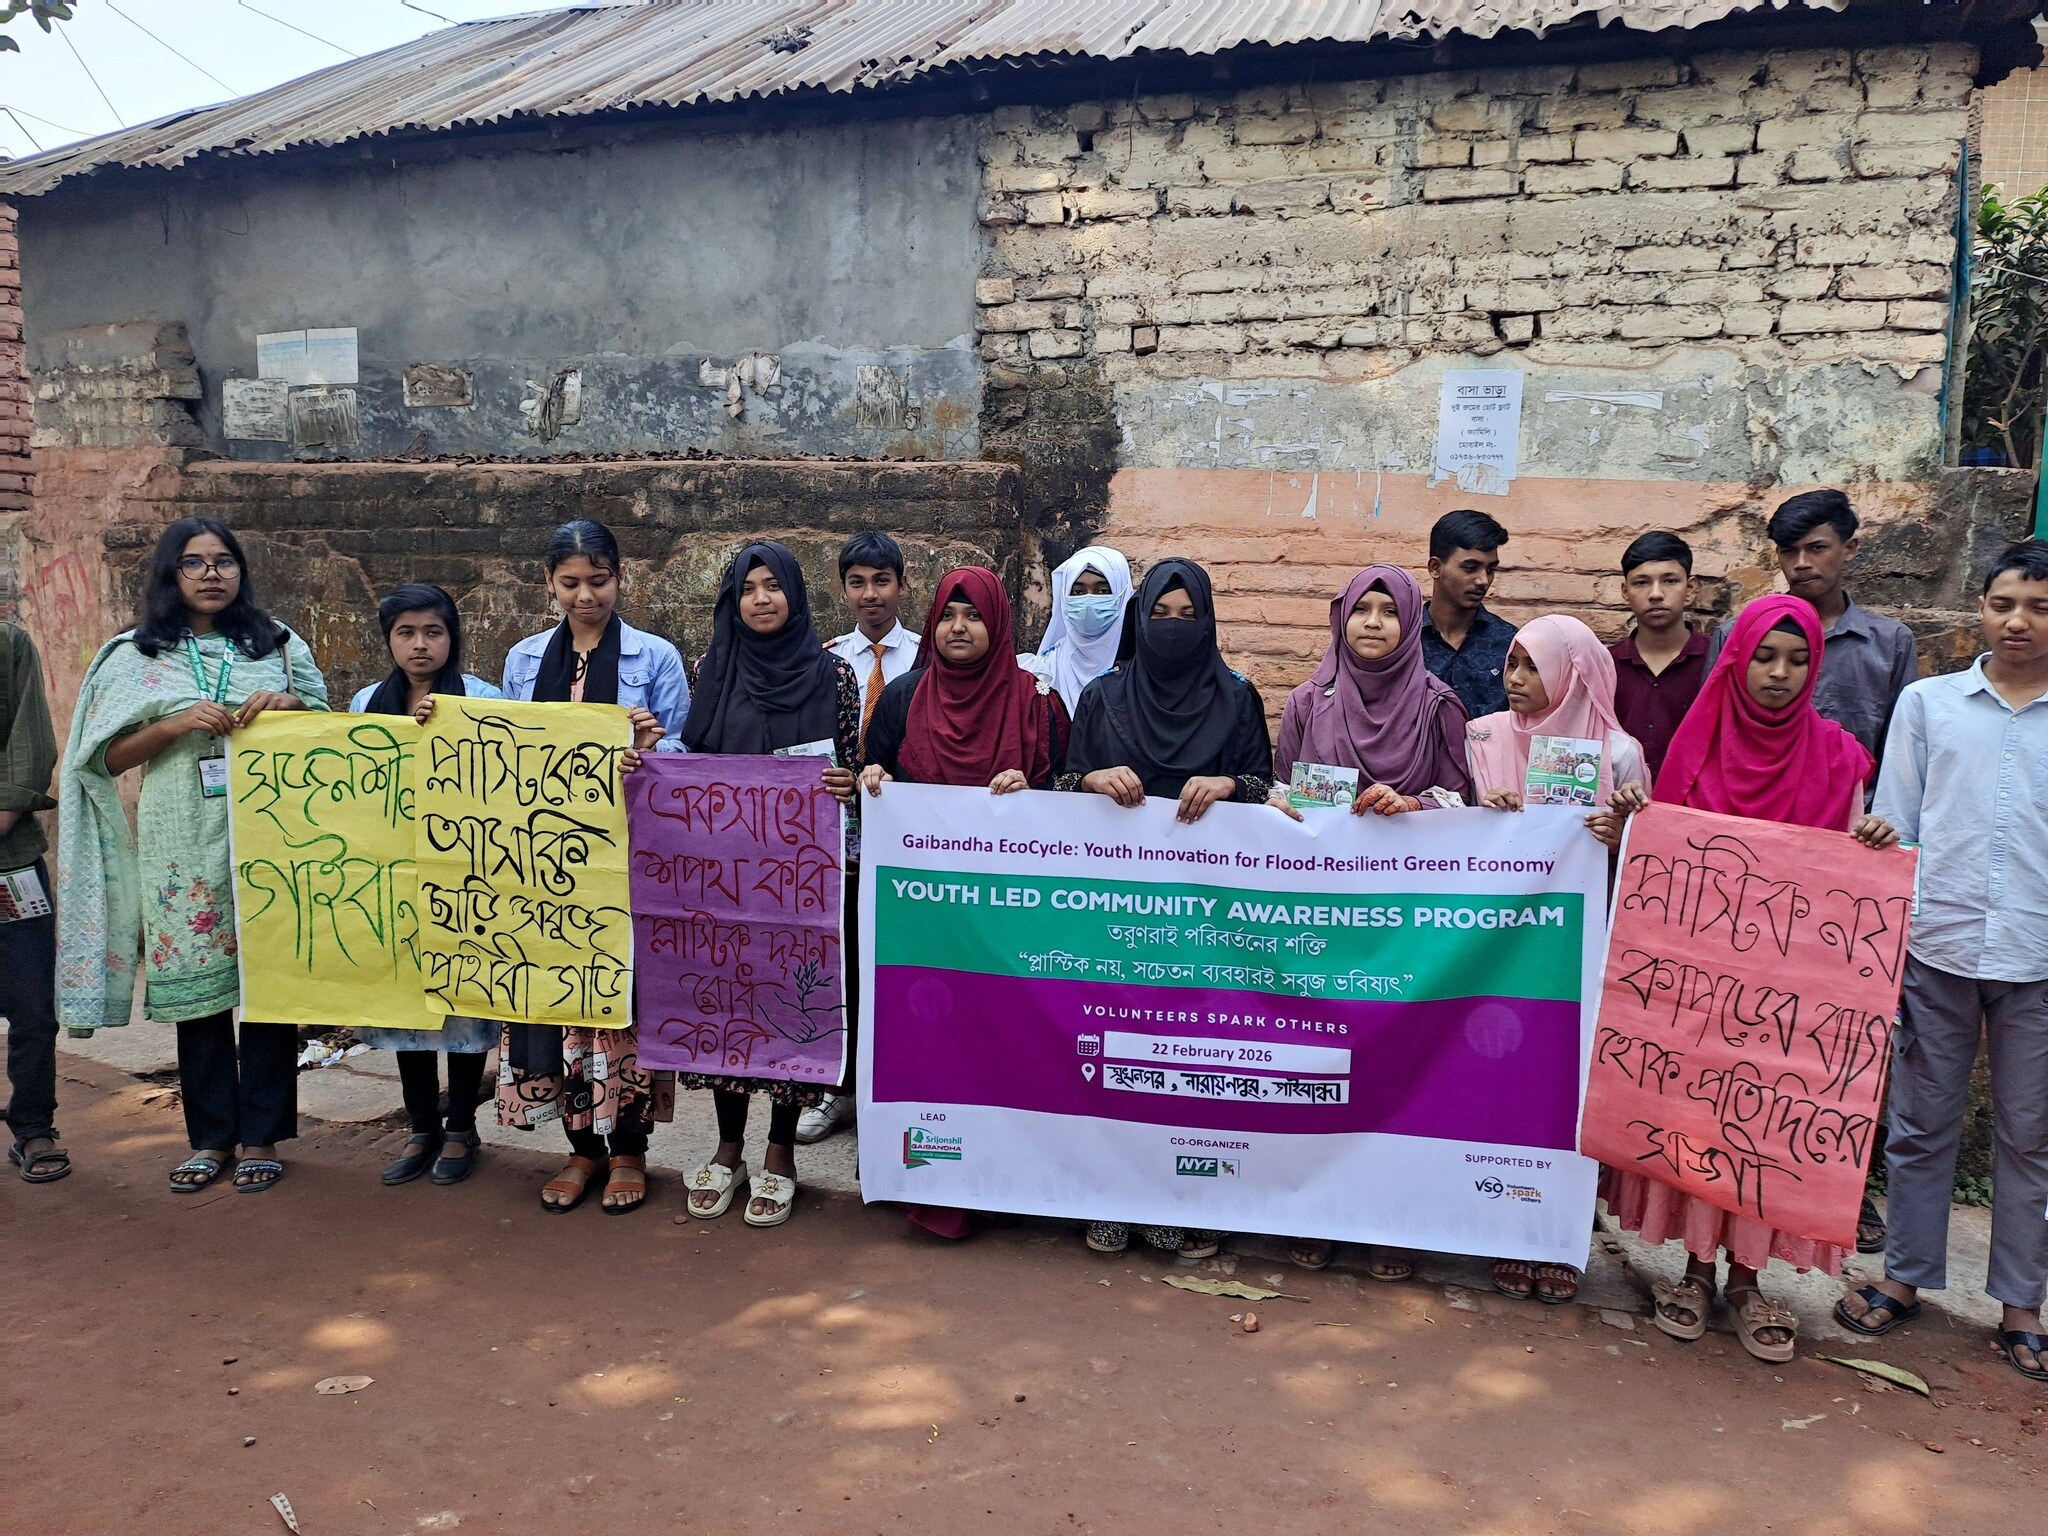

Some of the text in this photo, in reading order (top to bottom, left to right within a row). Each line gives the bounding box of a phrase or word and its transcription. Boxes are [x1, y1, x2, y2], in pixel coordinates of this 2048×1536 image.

[1456, 385, 1506, 397] বাসা ভাড়া
[902, 833, 1555, 875] Gaibandha EcoCycle: Youth Innovation for Flood-Resilient Green Economy
[752, 844, 843, 914] করি
[891, 879, 1565, 929] YOUTH LED COMMUNITY AWARENESS PROGRAM
[1107, 923, 1329, 956] তরুণরাই পরিবর্তনের শক্তি
[1095, 958, 1126, 982] নয়,
[1132, 961, 1195, 982] সচেতন
[1201, 964, 1276, 990] ব্যবহারই
[1281, 972, 1327, 998] সবুজ
[1083, 1004, 1349, 1035] VOLUNTEERS SPARK OTHERS
[1152, 1043, 1273, 1062] 22 February 2026
[1271, 1076, 1341, 1104] গাইবান্ধা
[920, 1112, 947, 1122] LEAD
[910, 1143, 962, 1151] GAIBANDHA
[925, 1135, 962, 1145] Srijonshil
[1170, 1137, 1250, 1150] CO-ORGANIZER
[1178, 1157, 1217, 1171] NYF
[1465, 1153, 1552, 1169] SUPPORTED BY
[1475, 1180, 1504, 1193] VSO
[1512, 1189, 1542, 1198] spark
